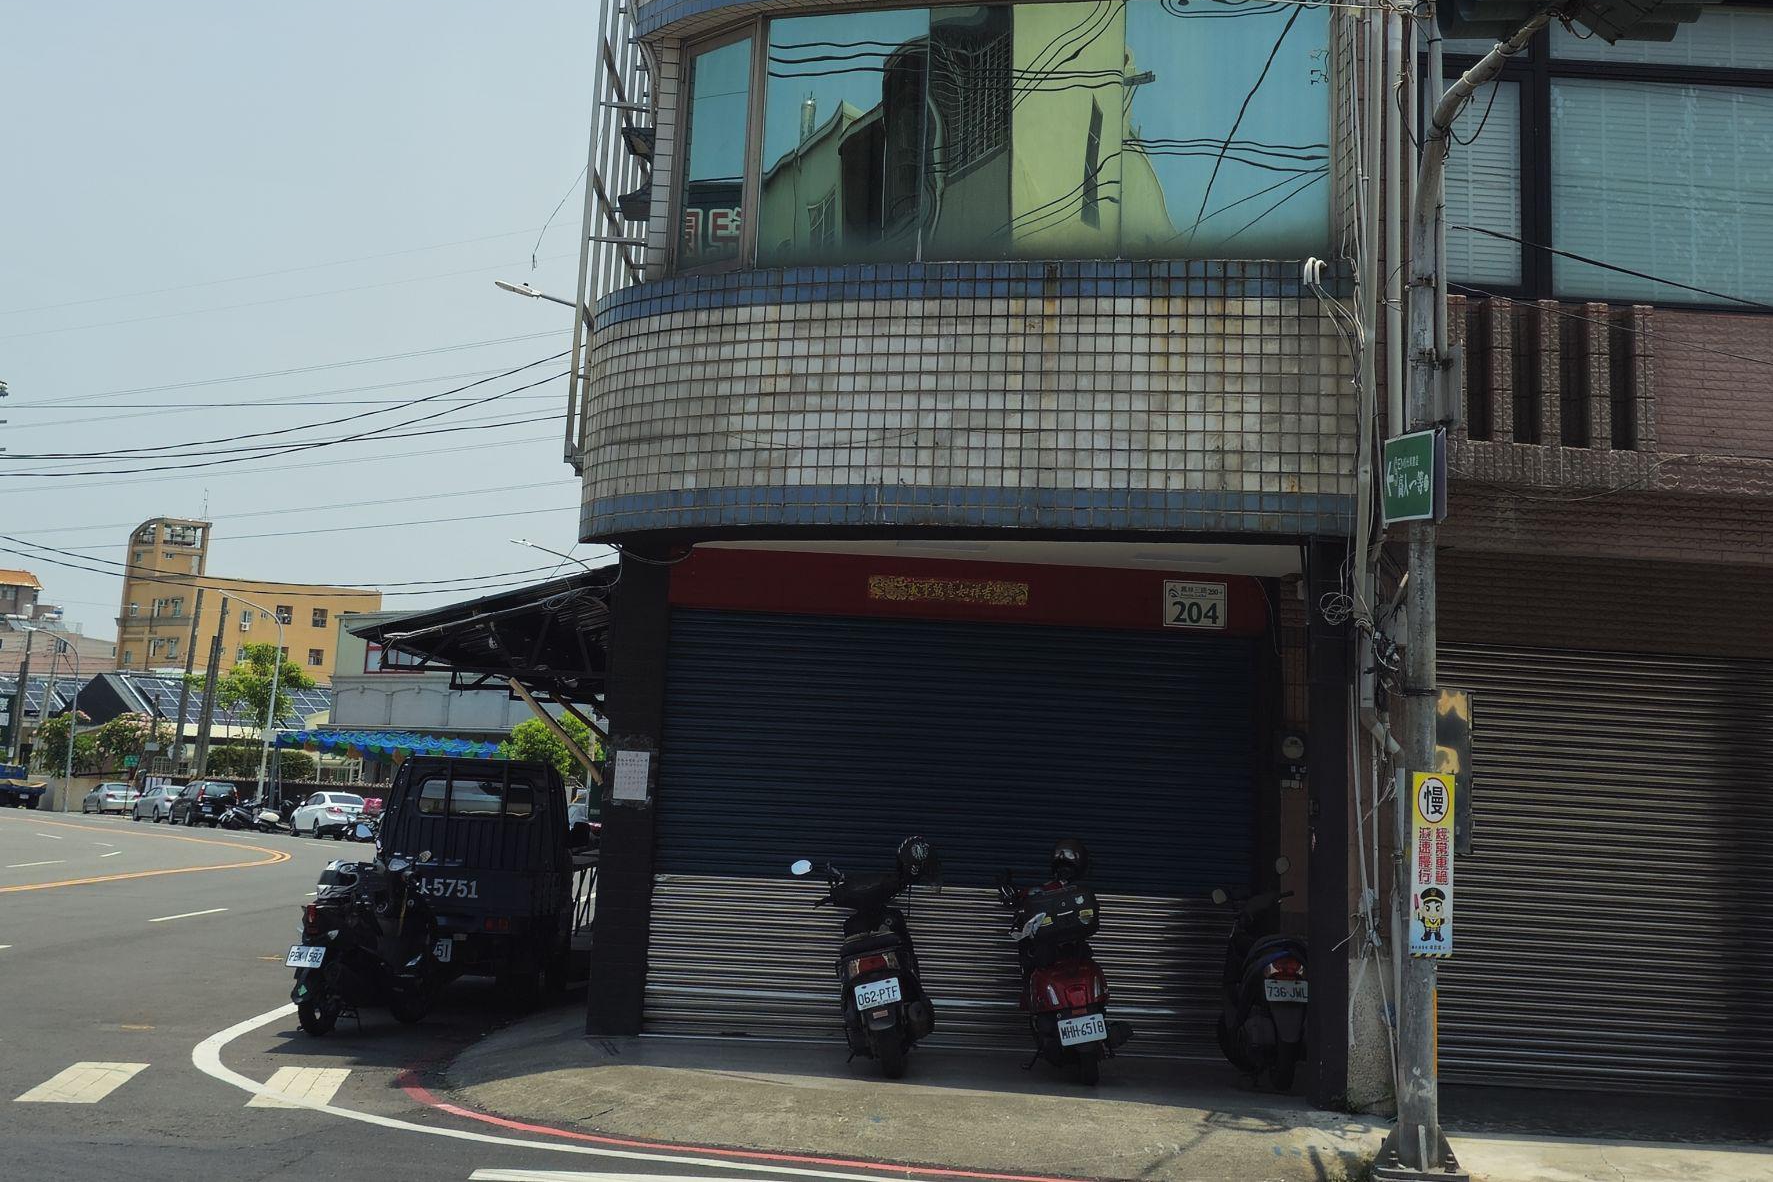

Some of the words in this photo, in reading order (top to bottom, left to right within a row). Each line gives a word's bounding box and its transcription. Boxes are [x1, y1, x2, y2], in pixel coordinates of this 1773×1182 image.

[1172, 600, 1219, 625] 204
[1424, 785, 1444, 816] 慢
[857, 985, 898, 1006] 062-PTF
